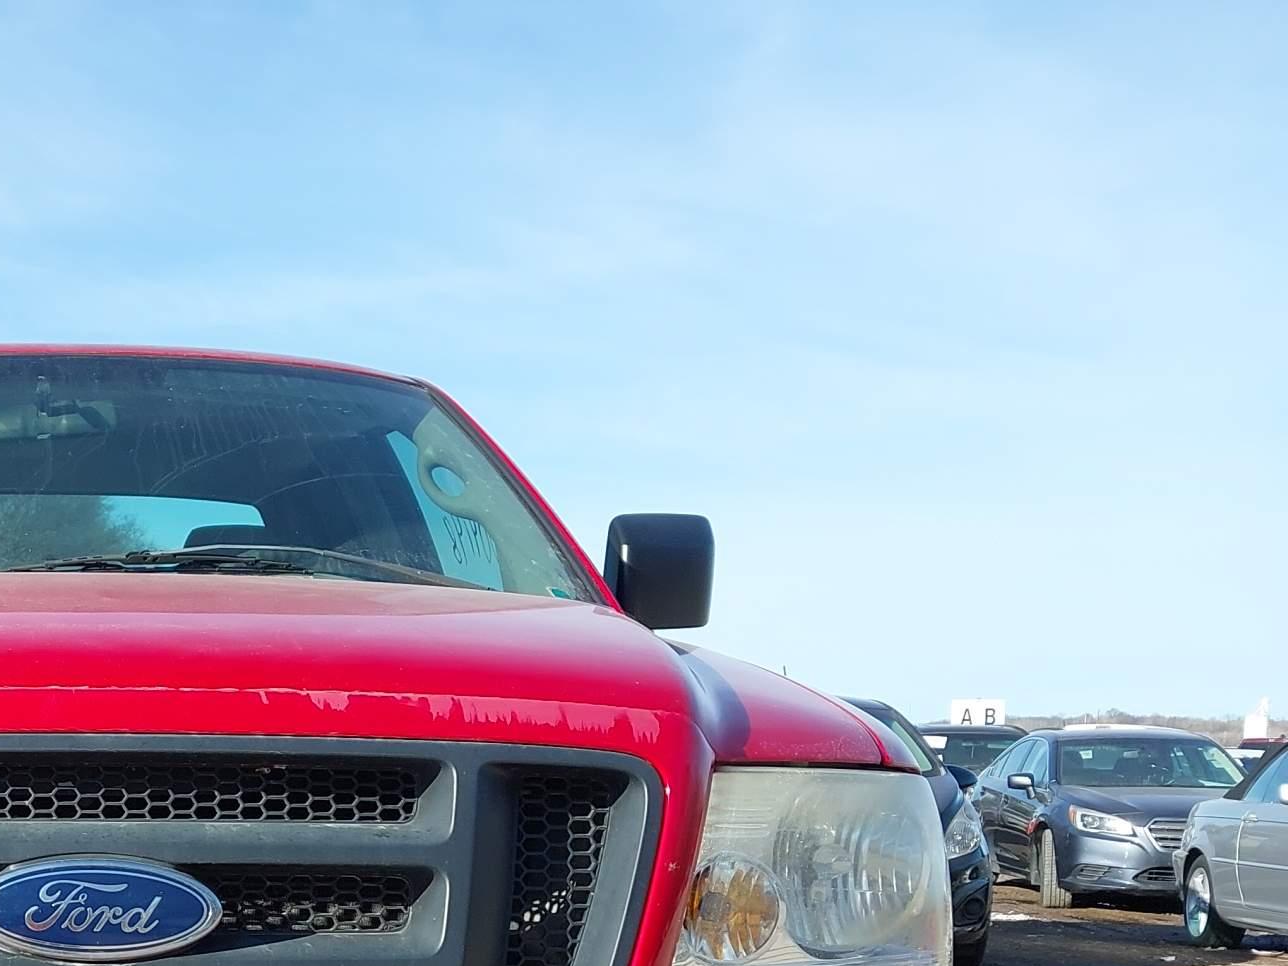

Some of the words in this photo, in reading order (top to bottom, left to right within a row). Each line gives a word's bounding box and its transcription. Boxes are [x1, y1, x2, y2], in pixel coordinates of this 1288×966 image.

[961, 708, 972, 725] A
[985, 708, 996, 726] B
[24, 879, 163, 934] Ford
